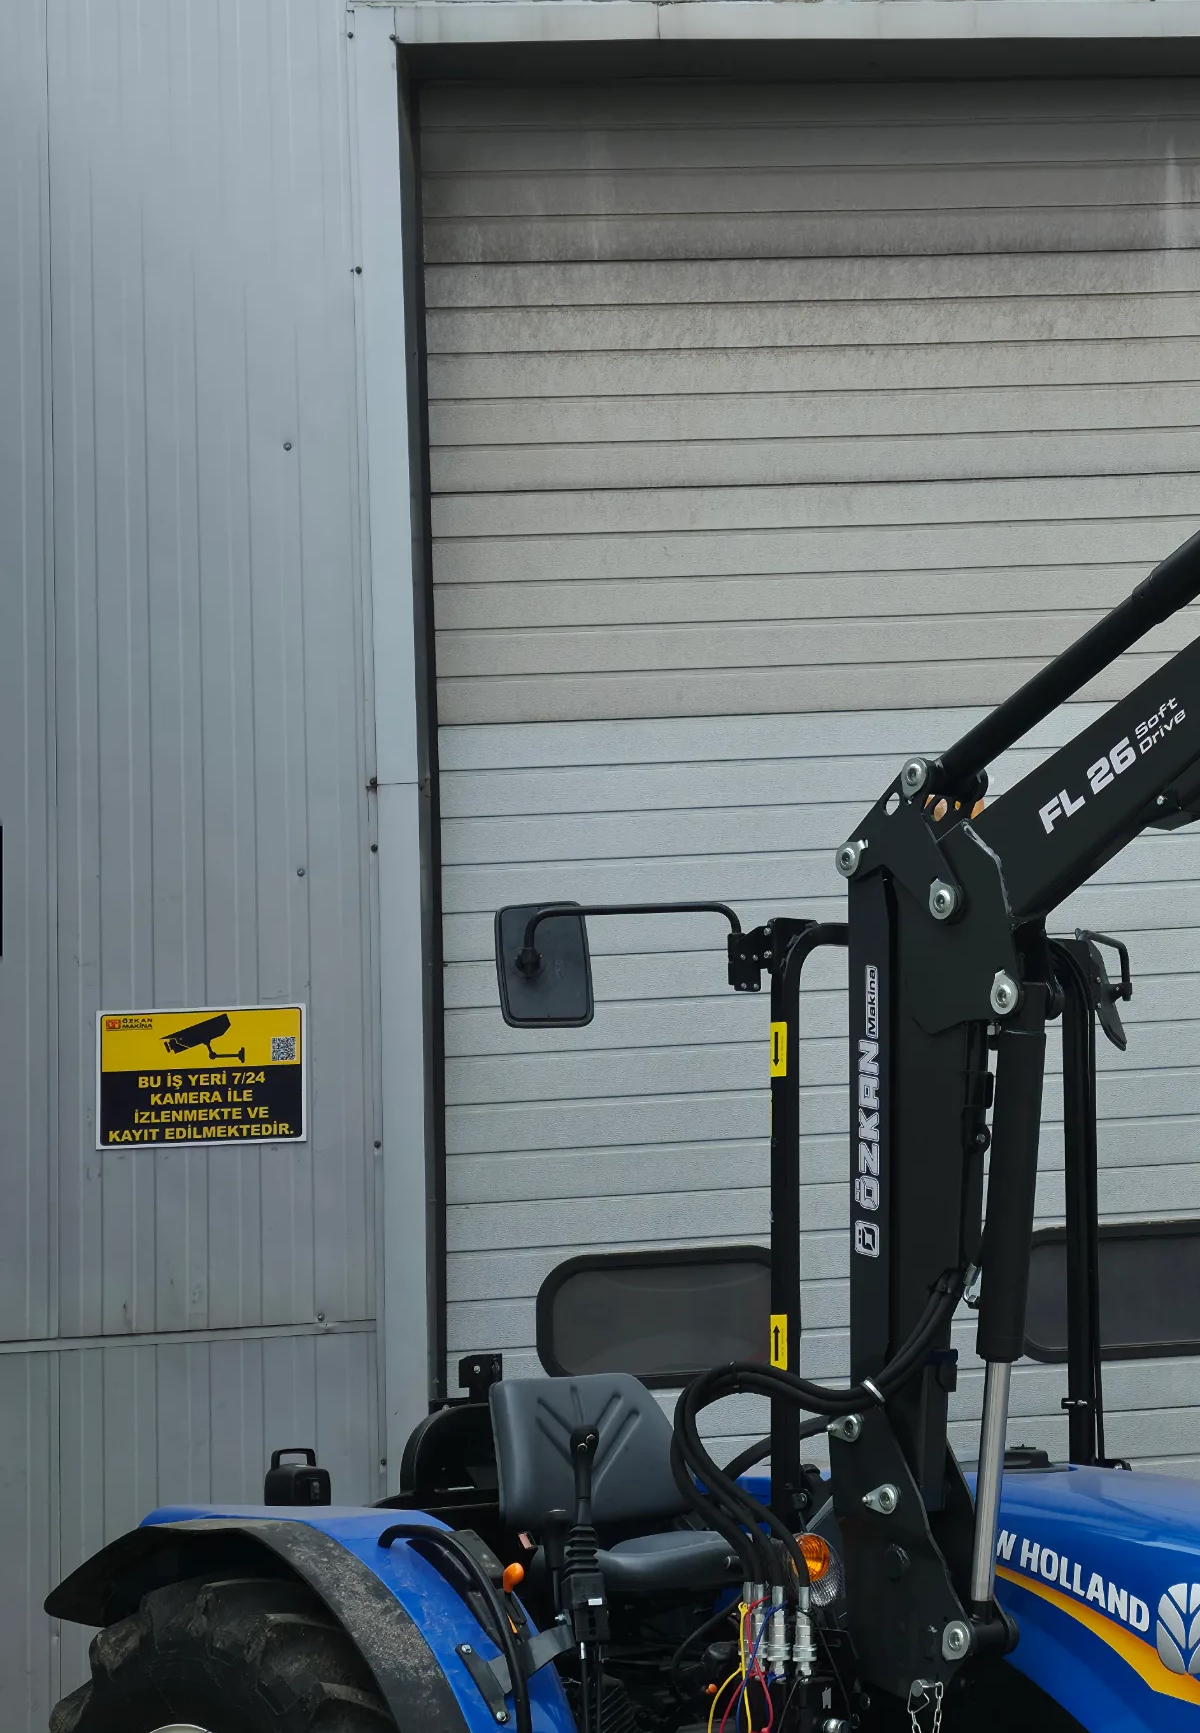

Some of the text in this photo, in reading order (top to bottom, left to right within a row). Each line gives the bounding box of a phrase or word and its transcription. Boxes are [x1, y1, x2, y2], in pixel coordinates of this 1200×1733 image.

[1134, 697, 1178, 739] Soft
[1139, 709, 1186, 755] Drive
[1038, 736, 1137, 835] FL 26
[867, 967, 878, 1037] Makina
[138, 1070, 266, 1090] BU İŞ YERİ 7/24
[150, 1088, 253, 1106] KAMERA İLE
[108, 1121, 294, 1143] KAYIT EDİLMEKTEDİR.
[134, 1106, 269, 1124] İZLENMEKTE VE
[855, 1039, 880, 1211] ÖZKAN
[1019, 1538, 1150, 1632] HOLLAND
